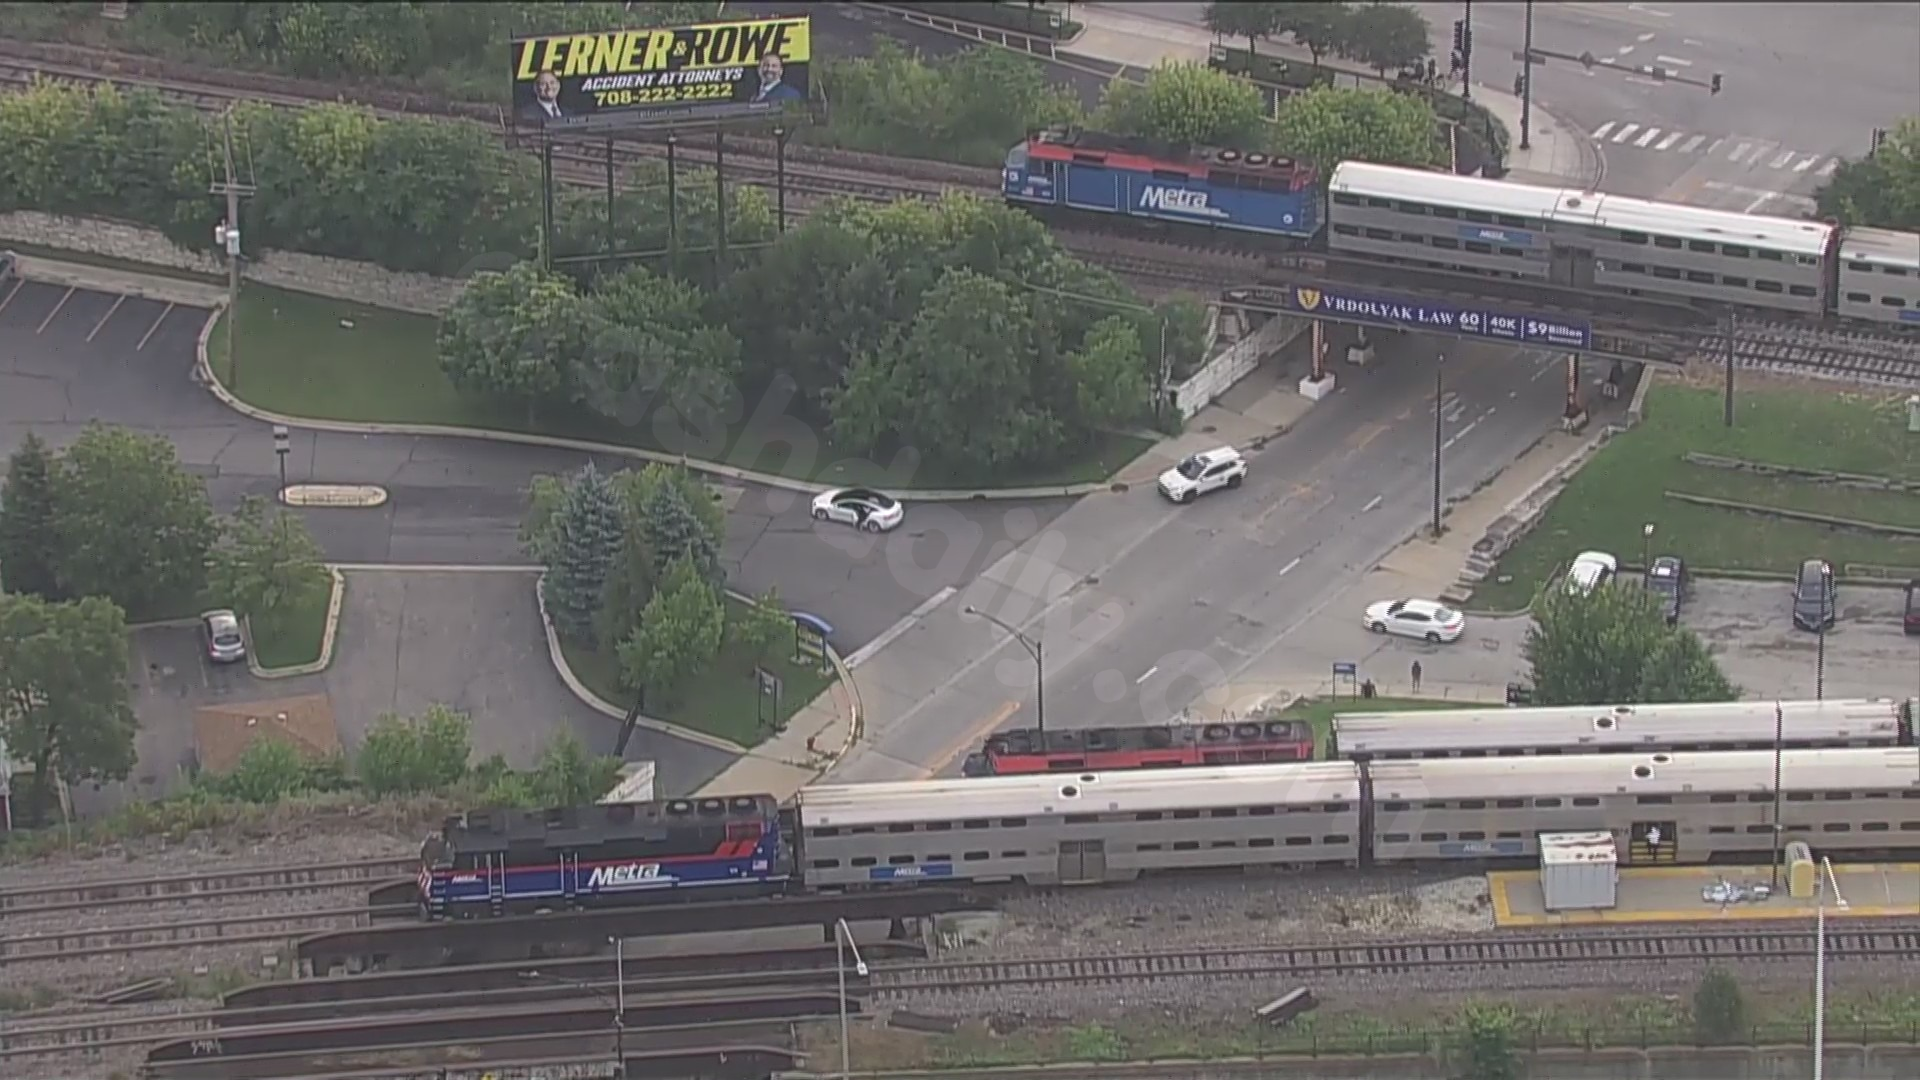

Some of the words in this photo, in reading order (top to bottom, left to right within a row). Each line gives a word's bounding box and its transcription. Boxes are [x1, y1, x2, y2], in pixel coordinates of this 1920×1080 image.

[516, 29, 675, 80] LERNER
[684, 22, 800, 67] ROWE
[581, 72, 658, 93] ACCIDENT
[656, 66, 744, 86] ATTORNEYS
[594, 82, 733, 106] 708-222-2222
[1139, 185, 1208, 208] Metra
[1323, 295, 1412, 320] VRDOLYAK
[1418, 308, 1454, 325] LAW
[1459, 311, 1480, 326] 60
[1490, 316, 1516, 331] 40K
[587, 862, 660, 887] Metra
